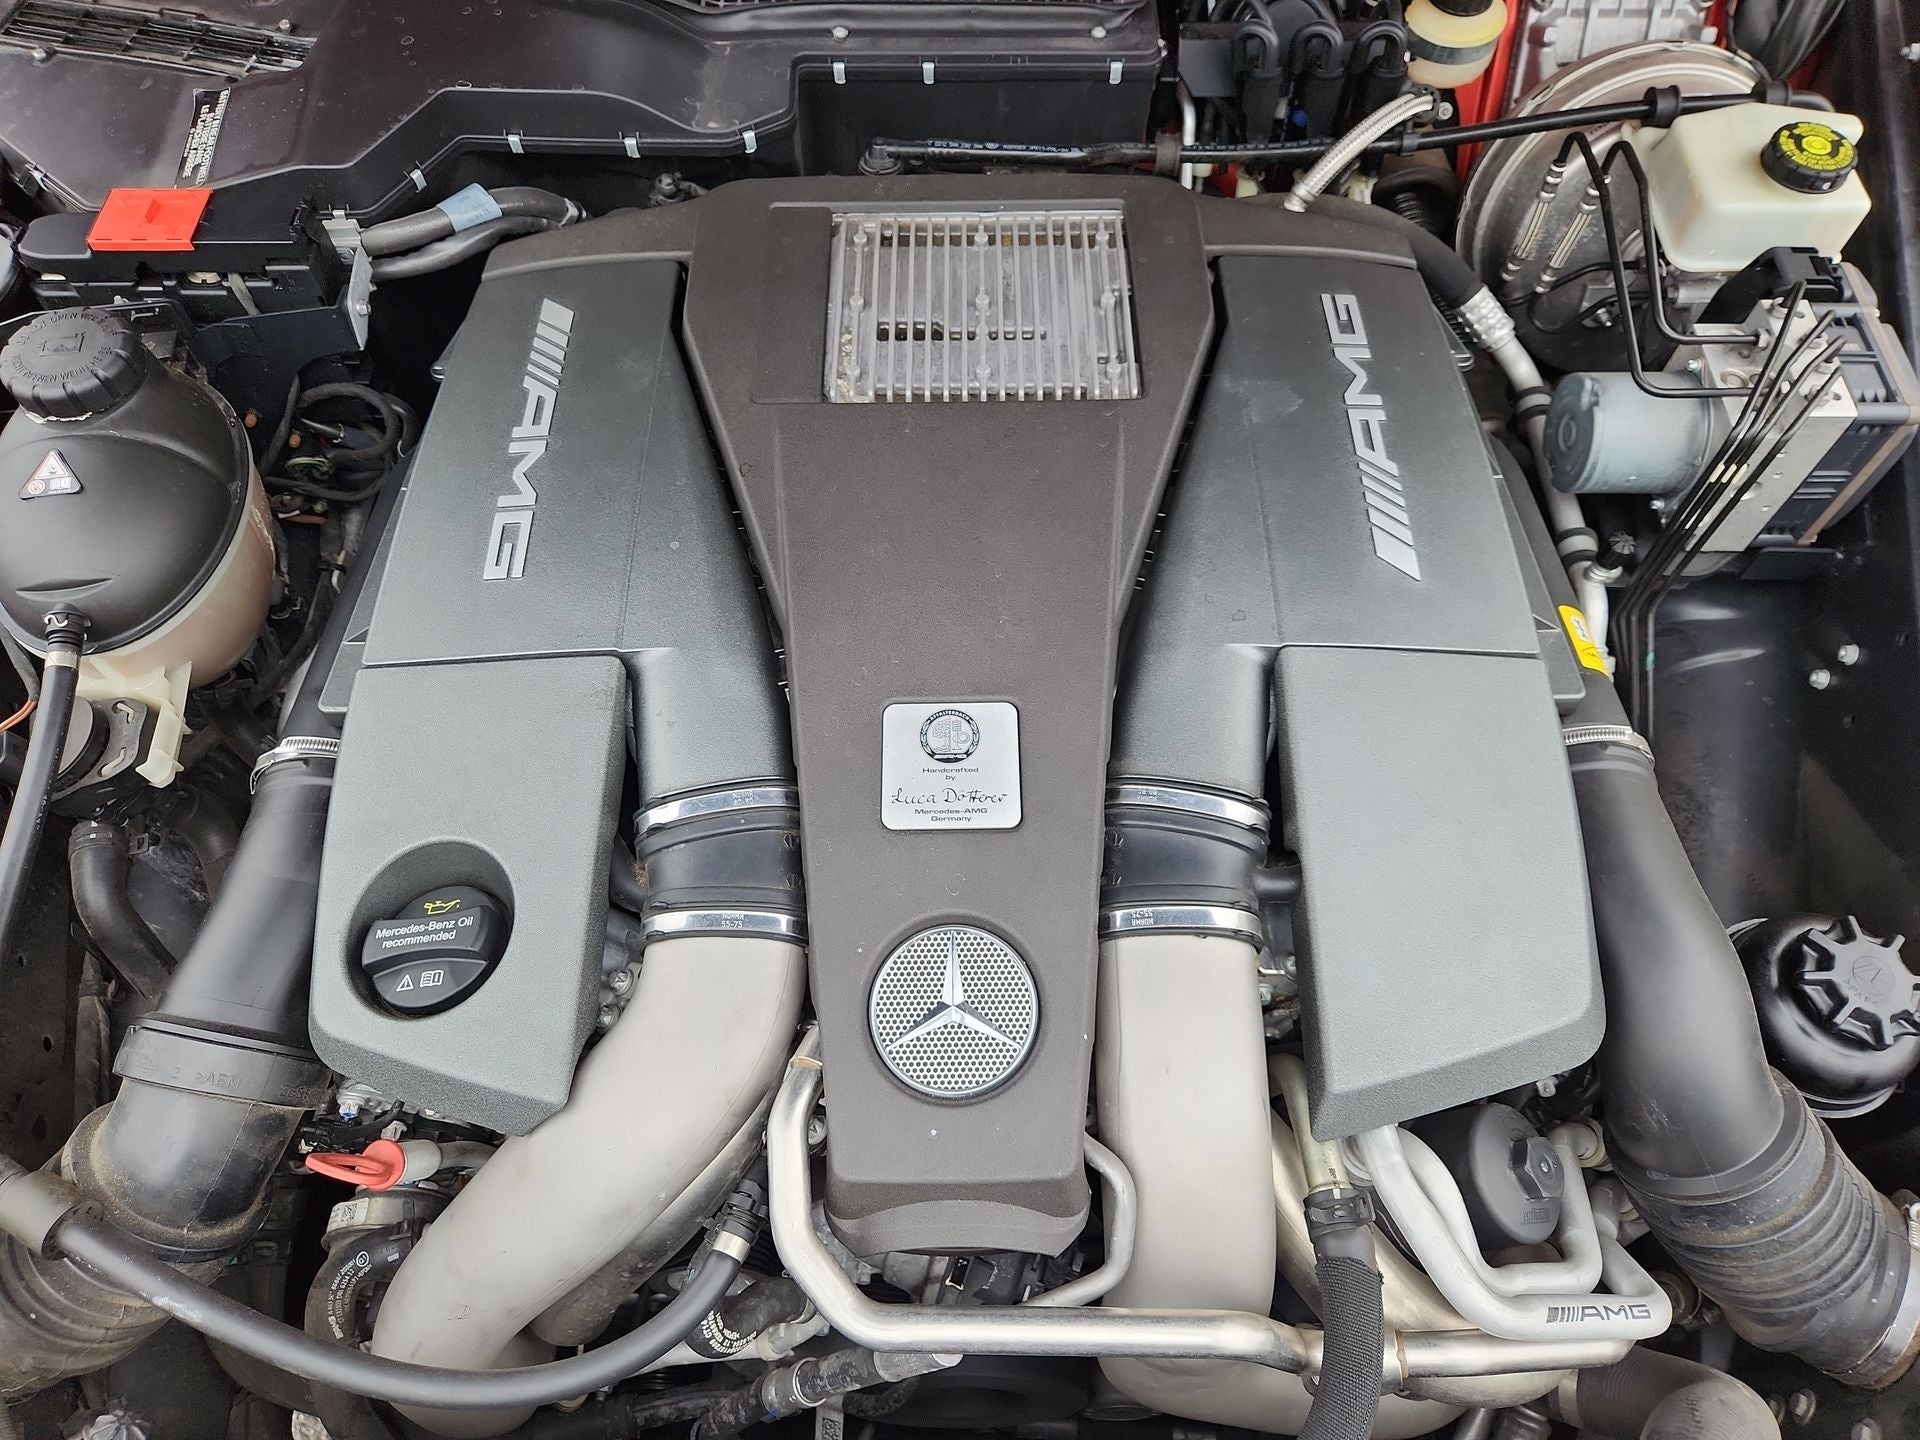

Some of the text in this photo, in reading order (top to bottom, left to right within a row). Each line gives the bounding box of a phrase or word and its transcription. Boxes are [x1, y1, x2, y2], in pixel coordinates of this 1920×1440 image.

[196, 146, 213, 185] FOOTWELL
[484, 374, 558, 581] AMG
[891, 787, 937, 804] Luca
[914, 807, 988, 815] Mercedes-AMG
[375, 916, 474, 940] Mercedes-Benz Oil
[721, 920, 743, 929] 55-75
[1131, 917, 1154, 926] NORMA
[382, 930, 456, 949] recommended
[1580, 1304, 1651, 1321] AMG
